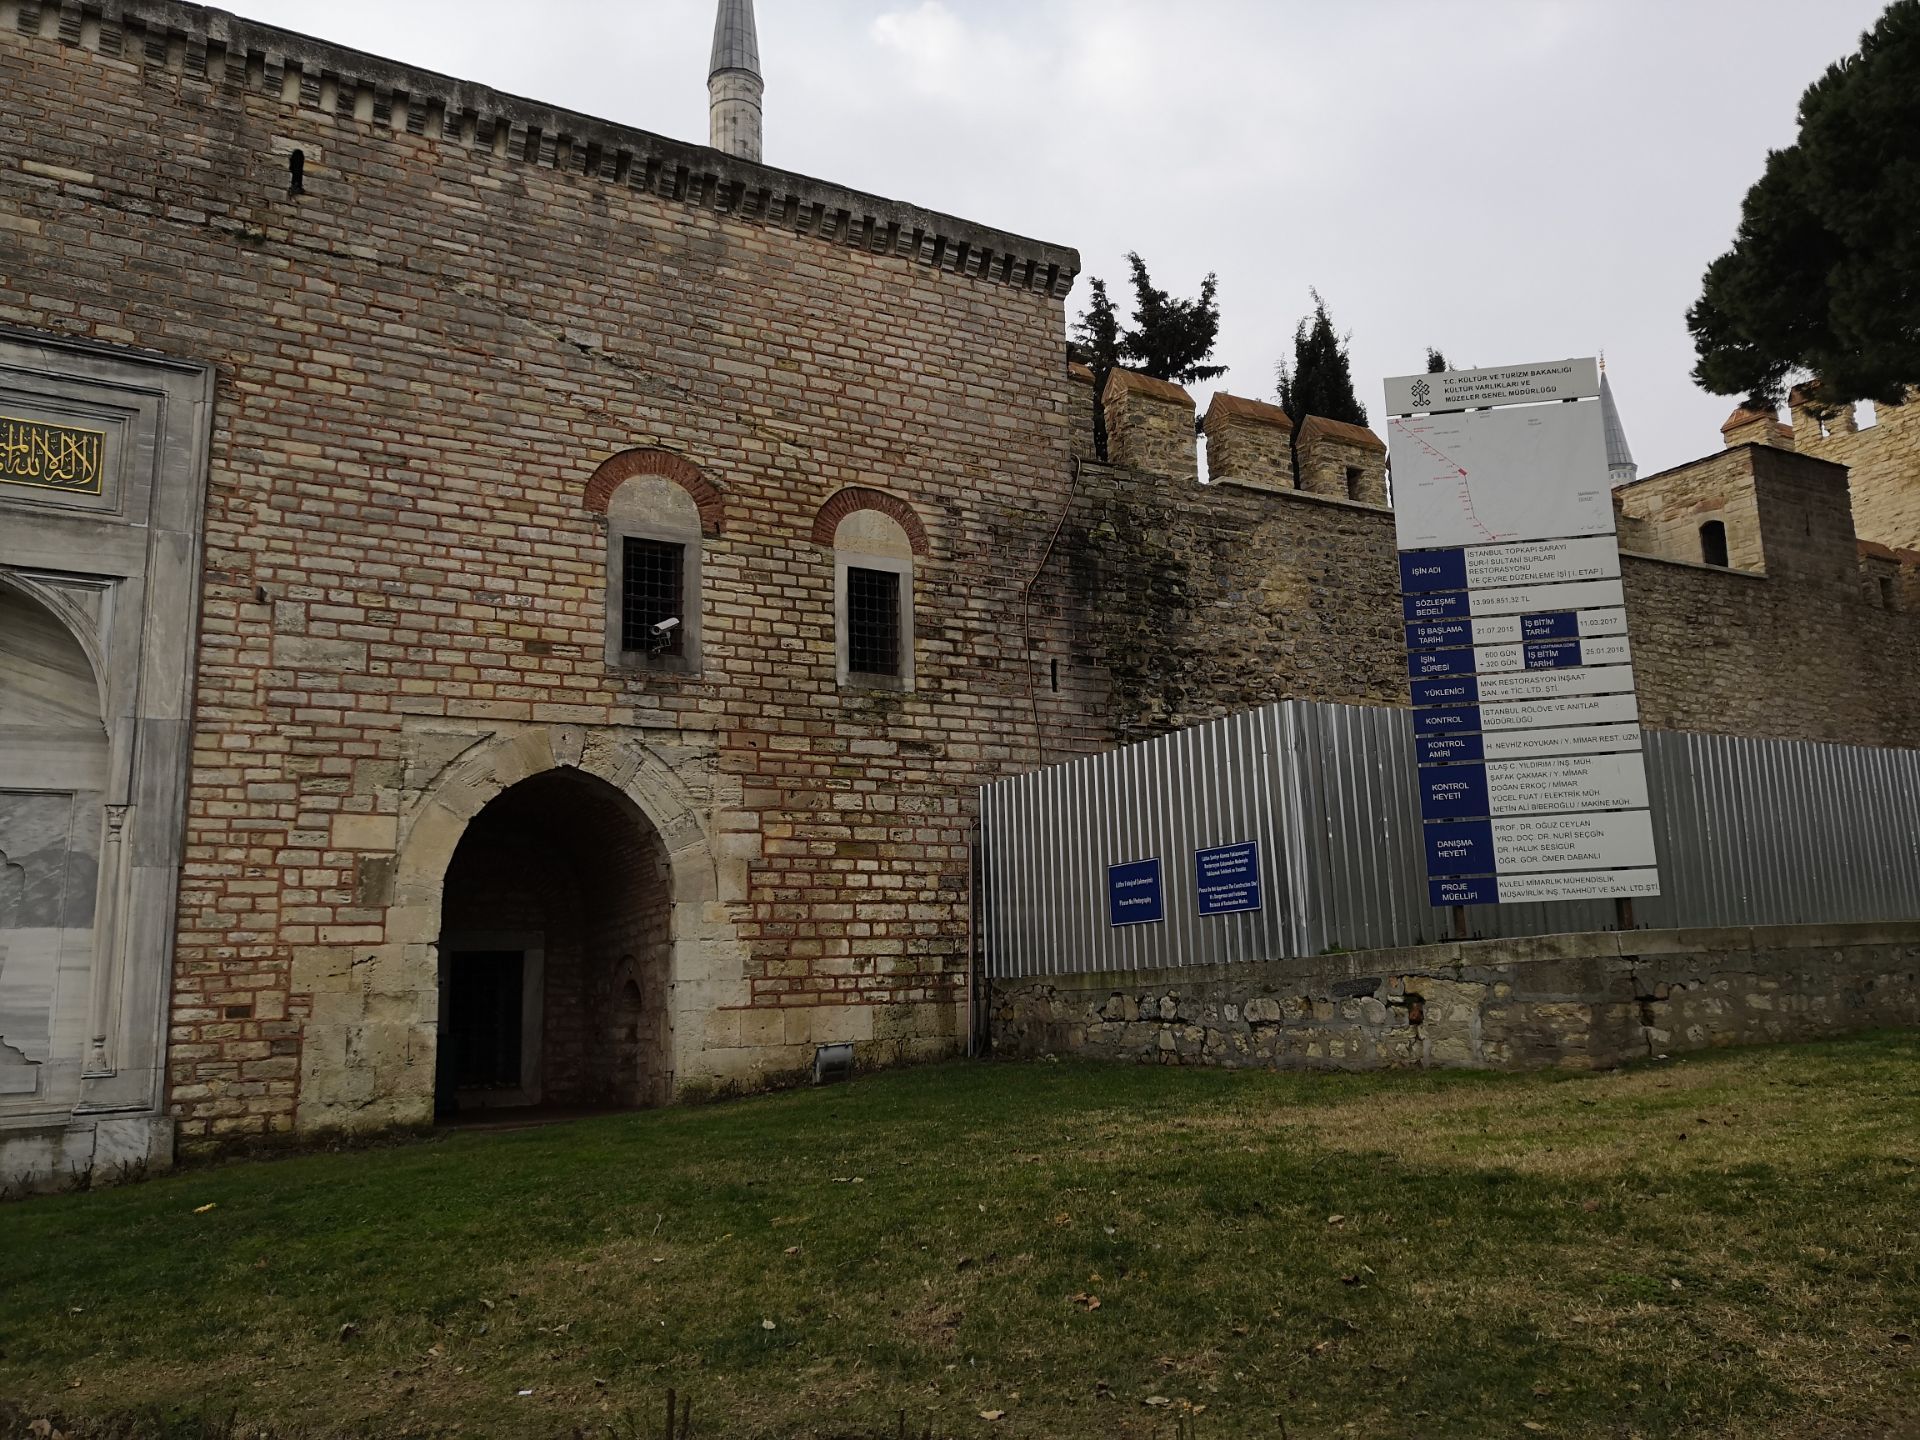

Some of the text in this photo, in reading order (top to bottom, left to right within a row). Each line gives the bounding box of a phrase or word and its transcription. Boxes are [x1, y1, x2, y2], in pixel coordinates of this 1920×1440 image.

[1458, 375, 1487, 383] KÜLTÜR
[1501, 370, 1528, 379] TURİZM
[1531, 367, 1572, 377] BAKANLIĞI
[1444, 385, 1474, 394] KÜLTÜR
[1475, 382, 1519, 390] VARLIKLARI
[1445, 386, 1557, 403] MÜZELER GENEL MÜDÜRLÜĞÜ
[1467, 544, 1567, 557] İSTANBUL TOPKAPI SARAYI
[1524, 554, 1556, 563] SURLARI
[1412, 566, 1441, 576] İŞİN ADI
[1468, 564, 1531, 575] RESTORASYONU
[1482, 576, 1507, 584] ÇEVRE
[1510, 572, 1555, 581] DÜZENLEME
[1579, 568, 1599, 576] ETAP
[1416, 598, 1456, 607] SÖZLEŞME
[1416, 607, 1444, 616] BEDELİ
[1525, 618, 1554, 628] İŞ BİTİM
[1417, 626, 1463, 636] İŞ BAŞLAMA
[1525, 628, 1550, 636] TARİHİ
[1419, 636, 1444, 644] TARİHİ
[1485, 649, 1517, 659] 600 GÜN
[1528, 650, 1559, 659] İŞ BİTİM
[1420, 655, 1435, 664] İŞİN
[1486, 660, 1498, 668] 320
[1528, 659, 1554, 667] TARİHİ
[1421, 663, 1450, 673] SÜRESİ
[1499, 675, 1557, 686] RESTORASYON
[1558, 673, 1586, 682] İNŞAAT
[1424, 687, 1465, 697] YÜKLENİCİ
[1482, 706, 1519, 716] İSTANBUL
[1521, 704, 1553, 713] RÖLÖVE
[1425, 716, 1463, 725] KONTROL
[1483, 715, 1533, 725] MÜDÜRLÜĞÜ
[1428, 740, 1465, 749] KONTROL
[1573, 736, 1598, 744] MİMAR
[1429, 749, 1451, 758] AMİRİ
[1490, 774, 1514, 782] ŞAFAK
[1516, 772, 1548, 780] ÇAKMAK
[1562, 769, 1588, 777] MİMAR
[1431, 782, 1469, 791] KONTROL
[1491, 784, 1519, 792] DOĞAN
[1520, 782, 1547, 790] ERKOÇ
[1552, 780, 1578, 788] MİMAR
[1433, 792, 1461, 801] HEYETİ
[1492, 794, 1517, 802] YÜCEL
[1544, 790, 1581, 799] ELEKTRİK
[1493, 805, 1517, 813] METİN
[1518, 803, 1530, 811] ALİ
[1532, 801, 1575, 810] BİBEROĞLU
[1559, 820, 1591, 828] CEYLAN
[1553, 831, 1573, 839] NURİ
[1437, 839, 1473, 848] DANIŞMA
[1438, 848, 1467, 858] HEYETİ
[1499, 875, 1615, 888] KULELİ MİMARLIK MÜHENDİSLİK
[1441, 883, 1468, 891] PROJE
[1442, 891, 1478, 901] MÜELLİFİ
[1500, 889, 1544, 898] MÜŞAVİRLİK
